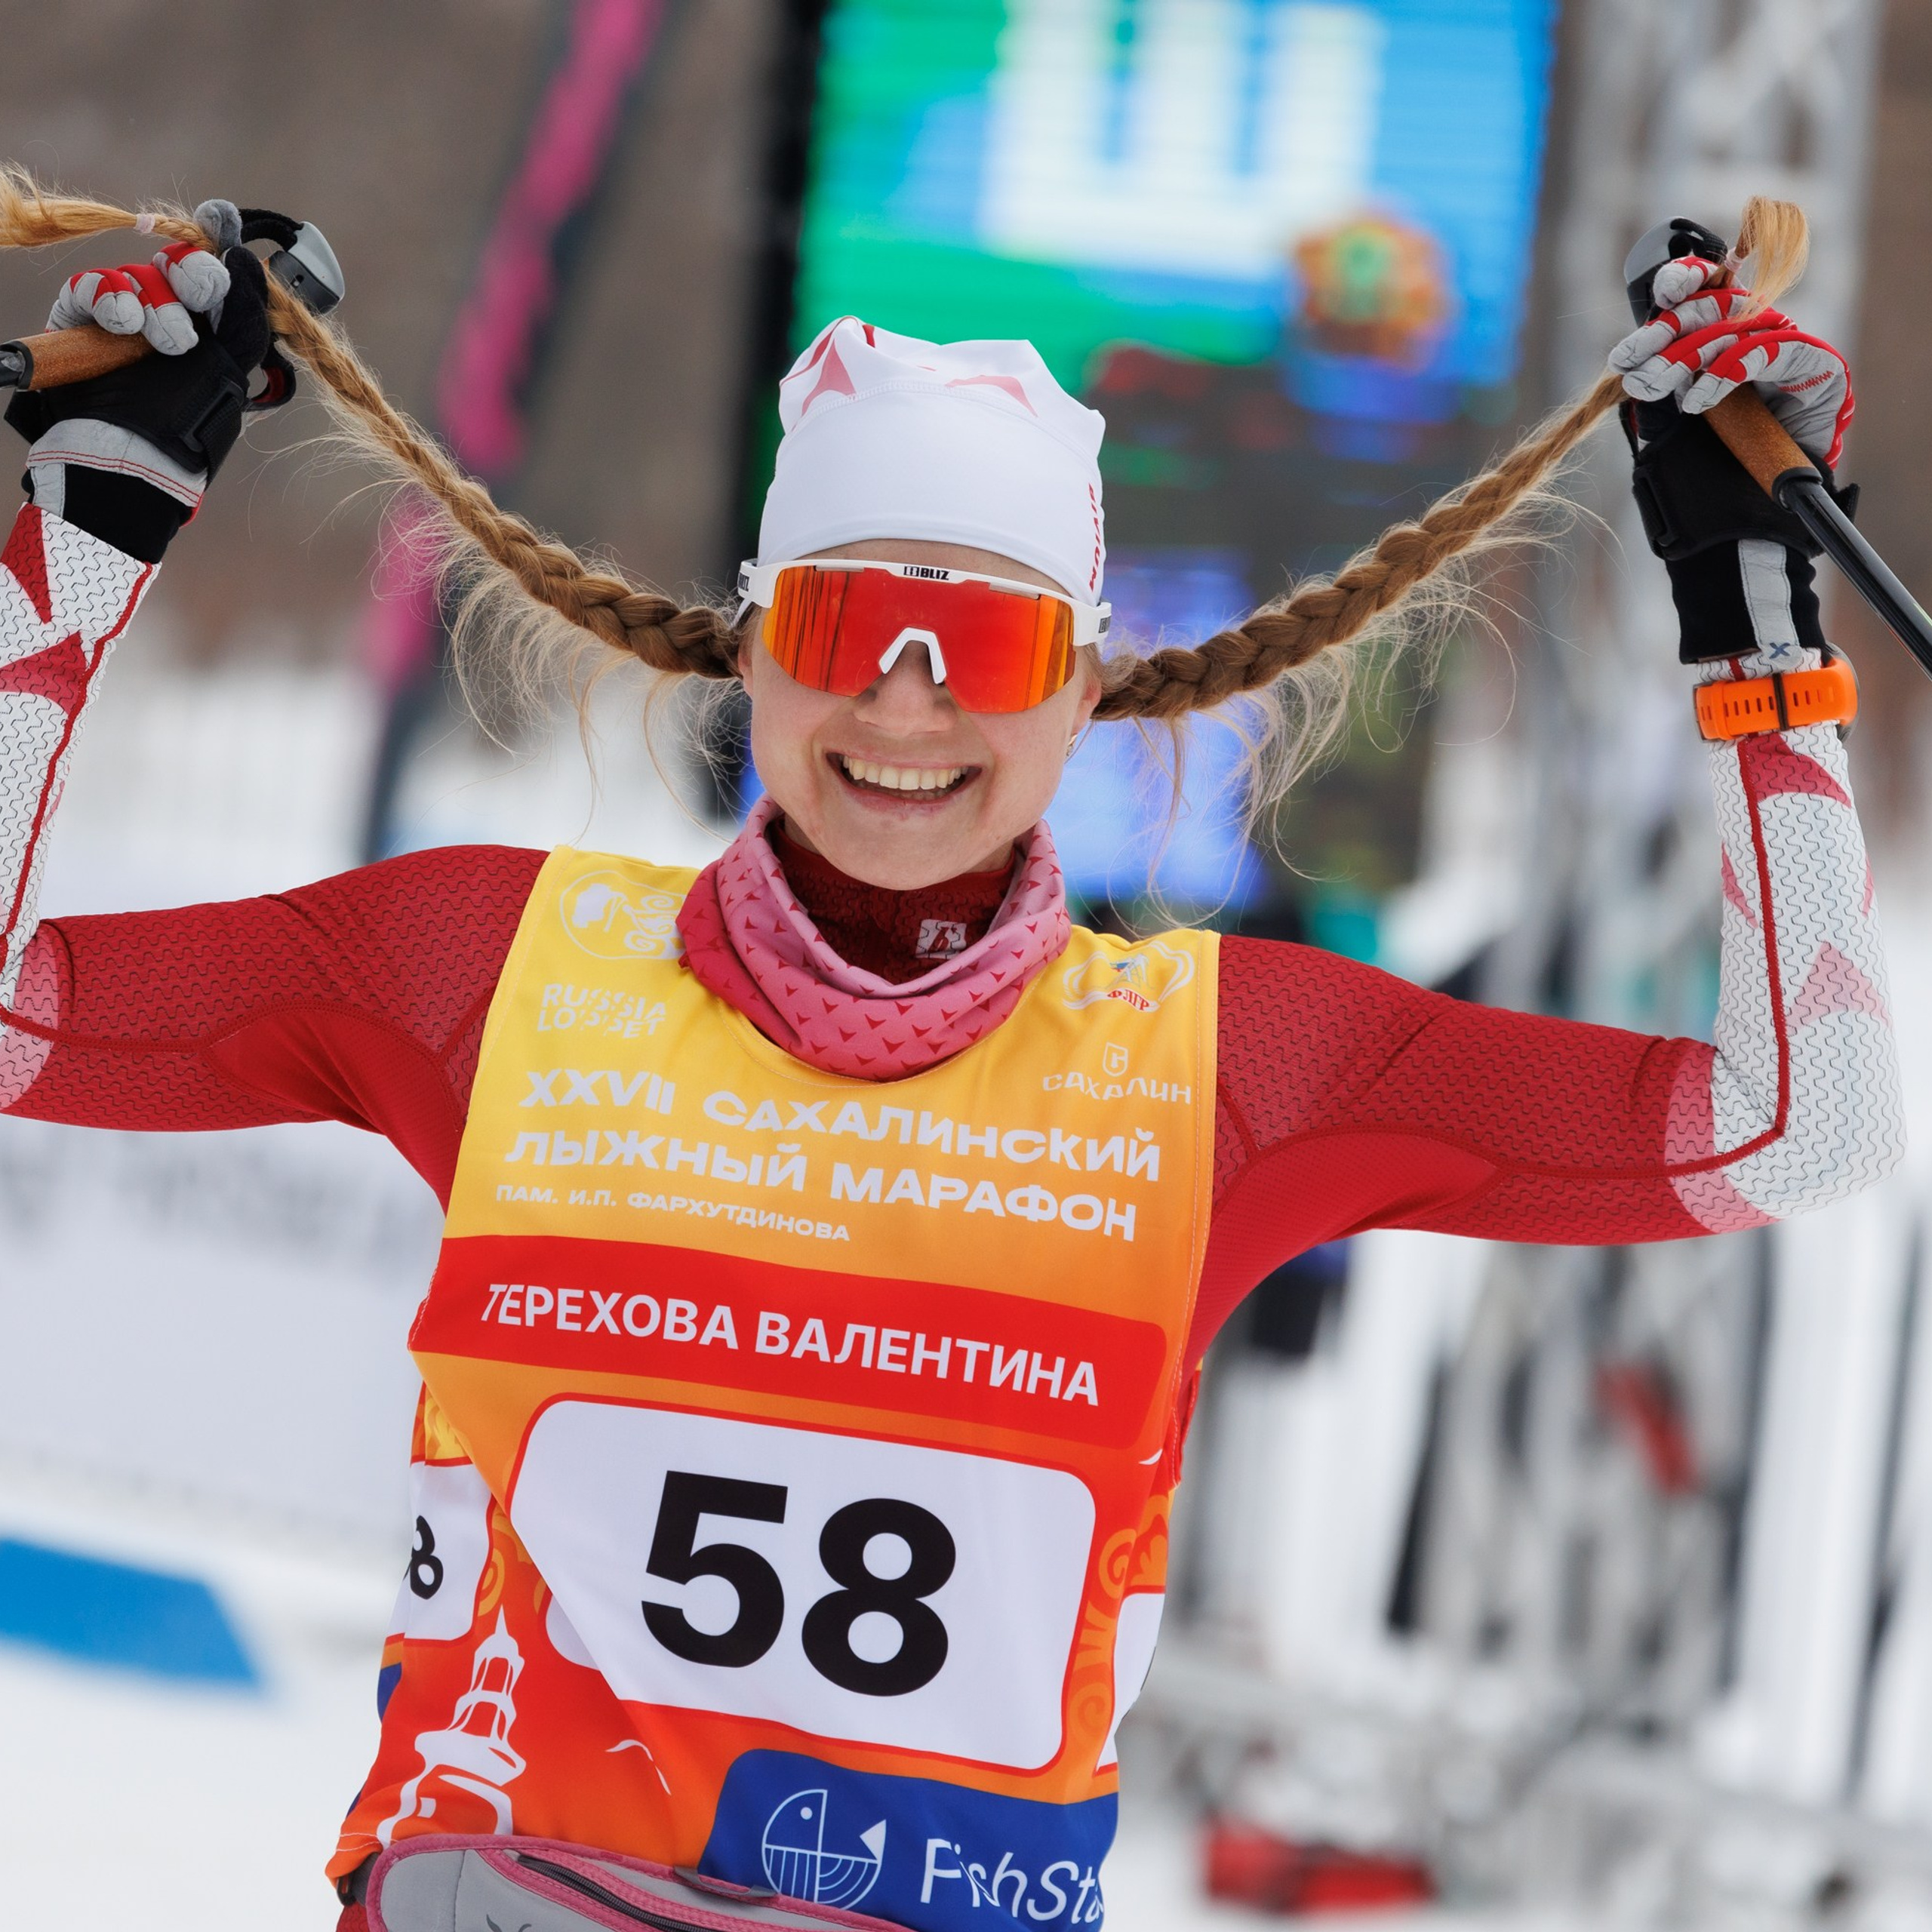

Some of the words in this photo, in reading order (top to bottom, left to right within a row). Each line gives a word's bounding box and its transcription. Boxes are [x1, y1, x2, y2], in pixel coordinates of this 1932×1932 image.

[920, 567, 951, 580] BLIZ
[542, 983, 666, 1020] RUSSIA
[1043, 1071, 1192, 1105] САХАЛИН
[702, 1091, 1161, 1183] САХАЛИНСКИЙ
[495, 1184, 558, 1204] ПАМ.
[568, 1189, 617, 1208] И.П.
[626, 1192, 851, 1241] ФАРХУТДИНОВА
[504, 1129, 808, 1192] ЛЫЖНЫЙ
[829, 1162, 1137, 1242] МАРАФОН
[480, 1283, 740, 1351] ТЕРЕХОВА
[754, 1310, 1099, 1407] ВАЛЕНТИНА
[403, 1515, 444, 1600] 8
[641, 1469, 956, 1697] 58
